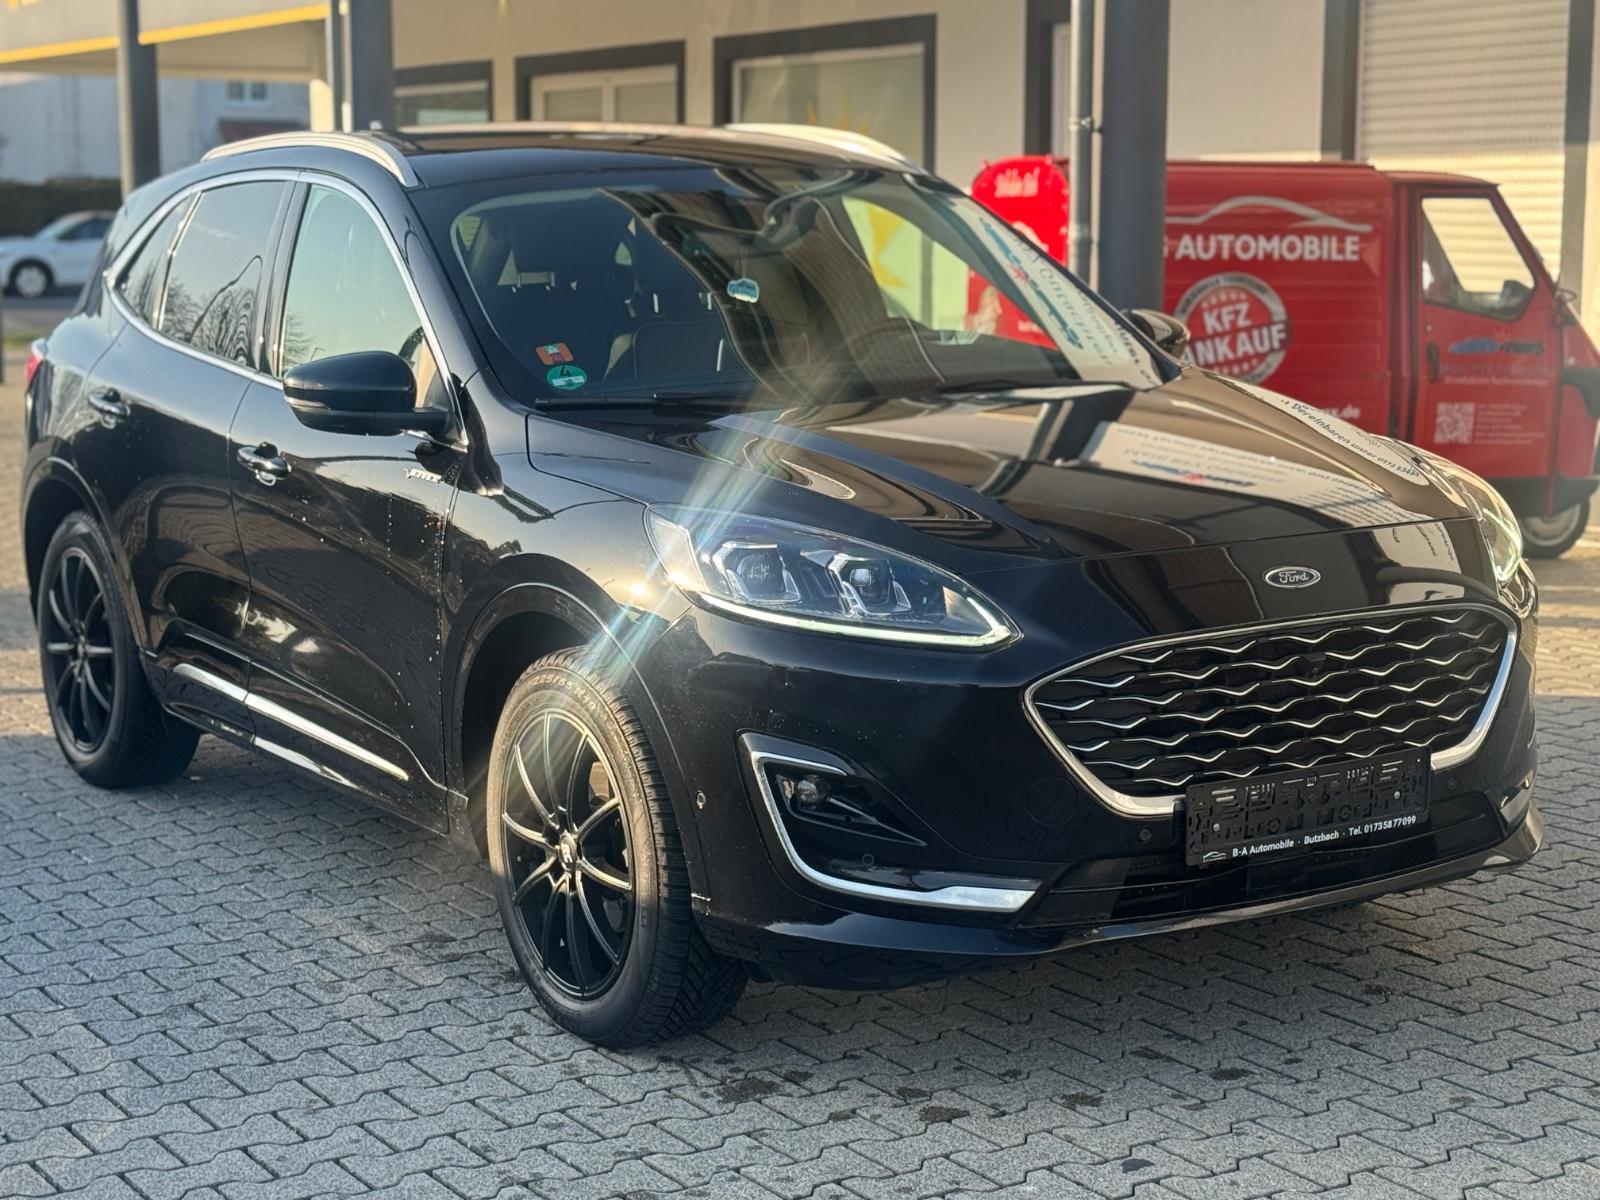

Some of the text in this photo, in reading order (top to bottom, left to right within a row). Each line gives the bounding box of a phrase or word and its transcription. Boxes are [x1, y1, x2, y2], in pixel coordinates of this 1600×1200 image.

[1174, 233, 1361, 261] AUTOMOBILE
[1203, 302, 1252, 335] KFZ
[1180, 322, 1287, 367] ANKAUF
[1232, 814, 1417, 858] B-A Automobile Butzbach Tel. 01735877099
